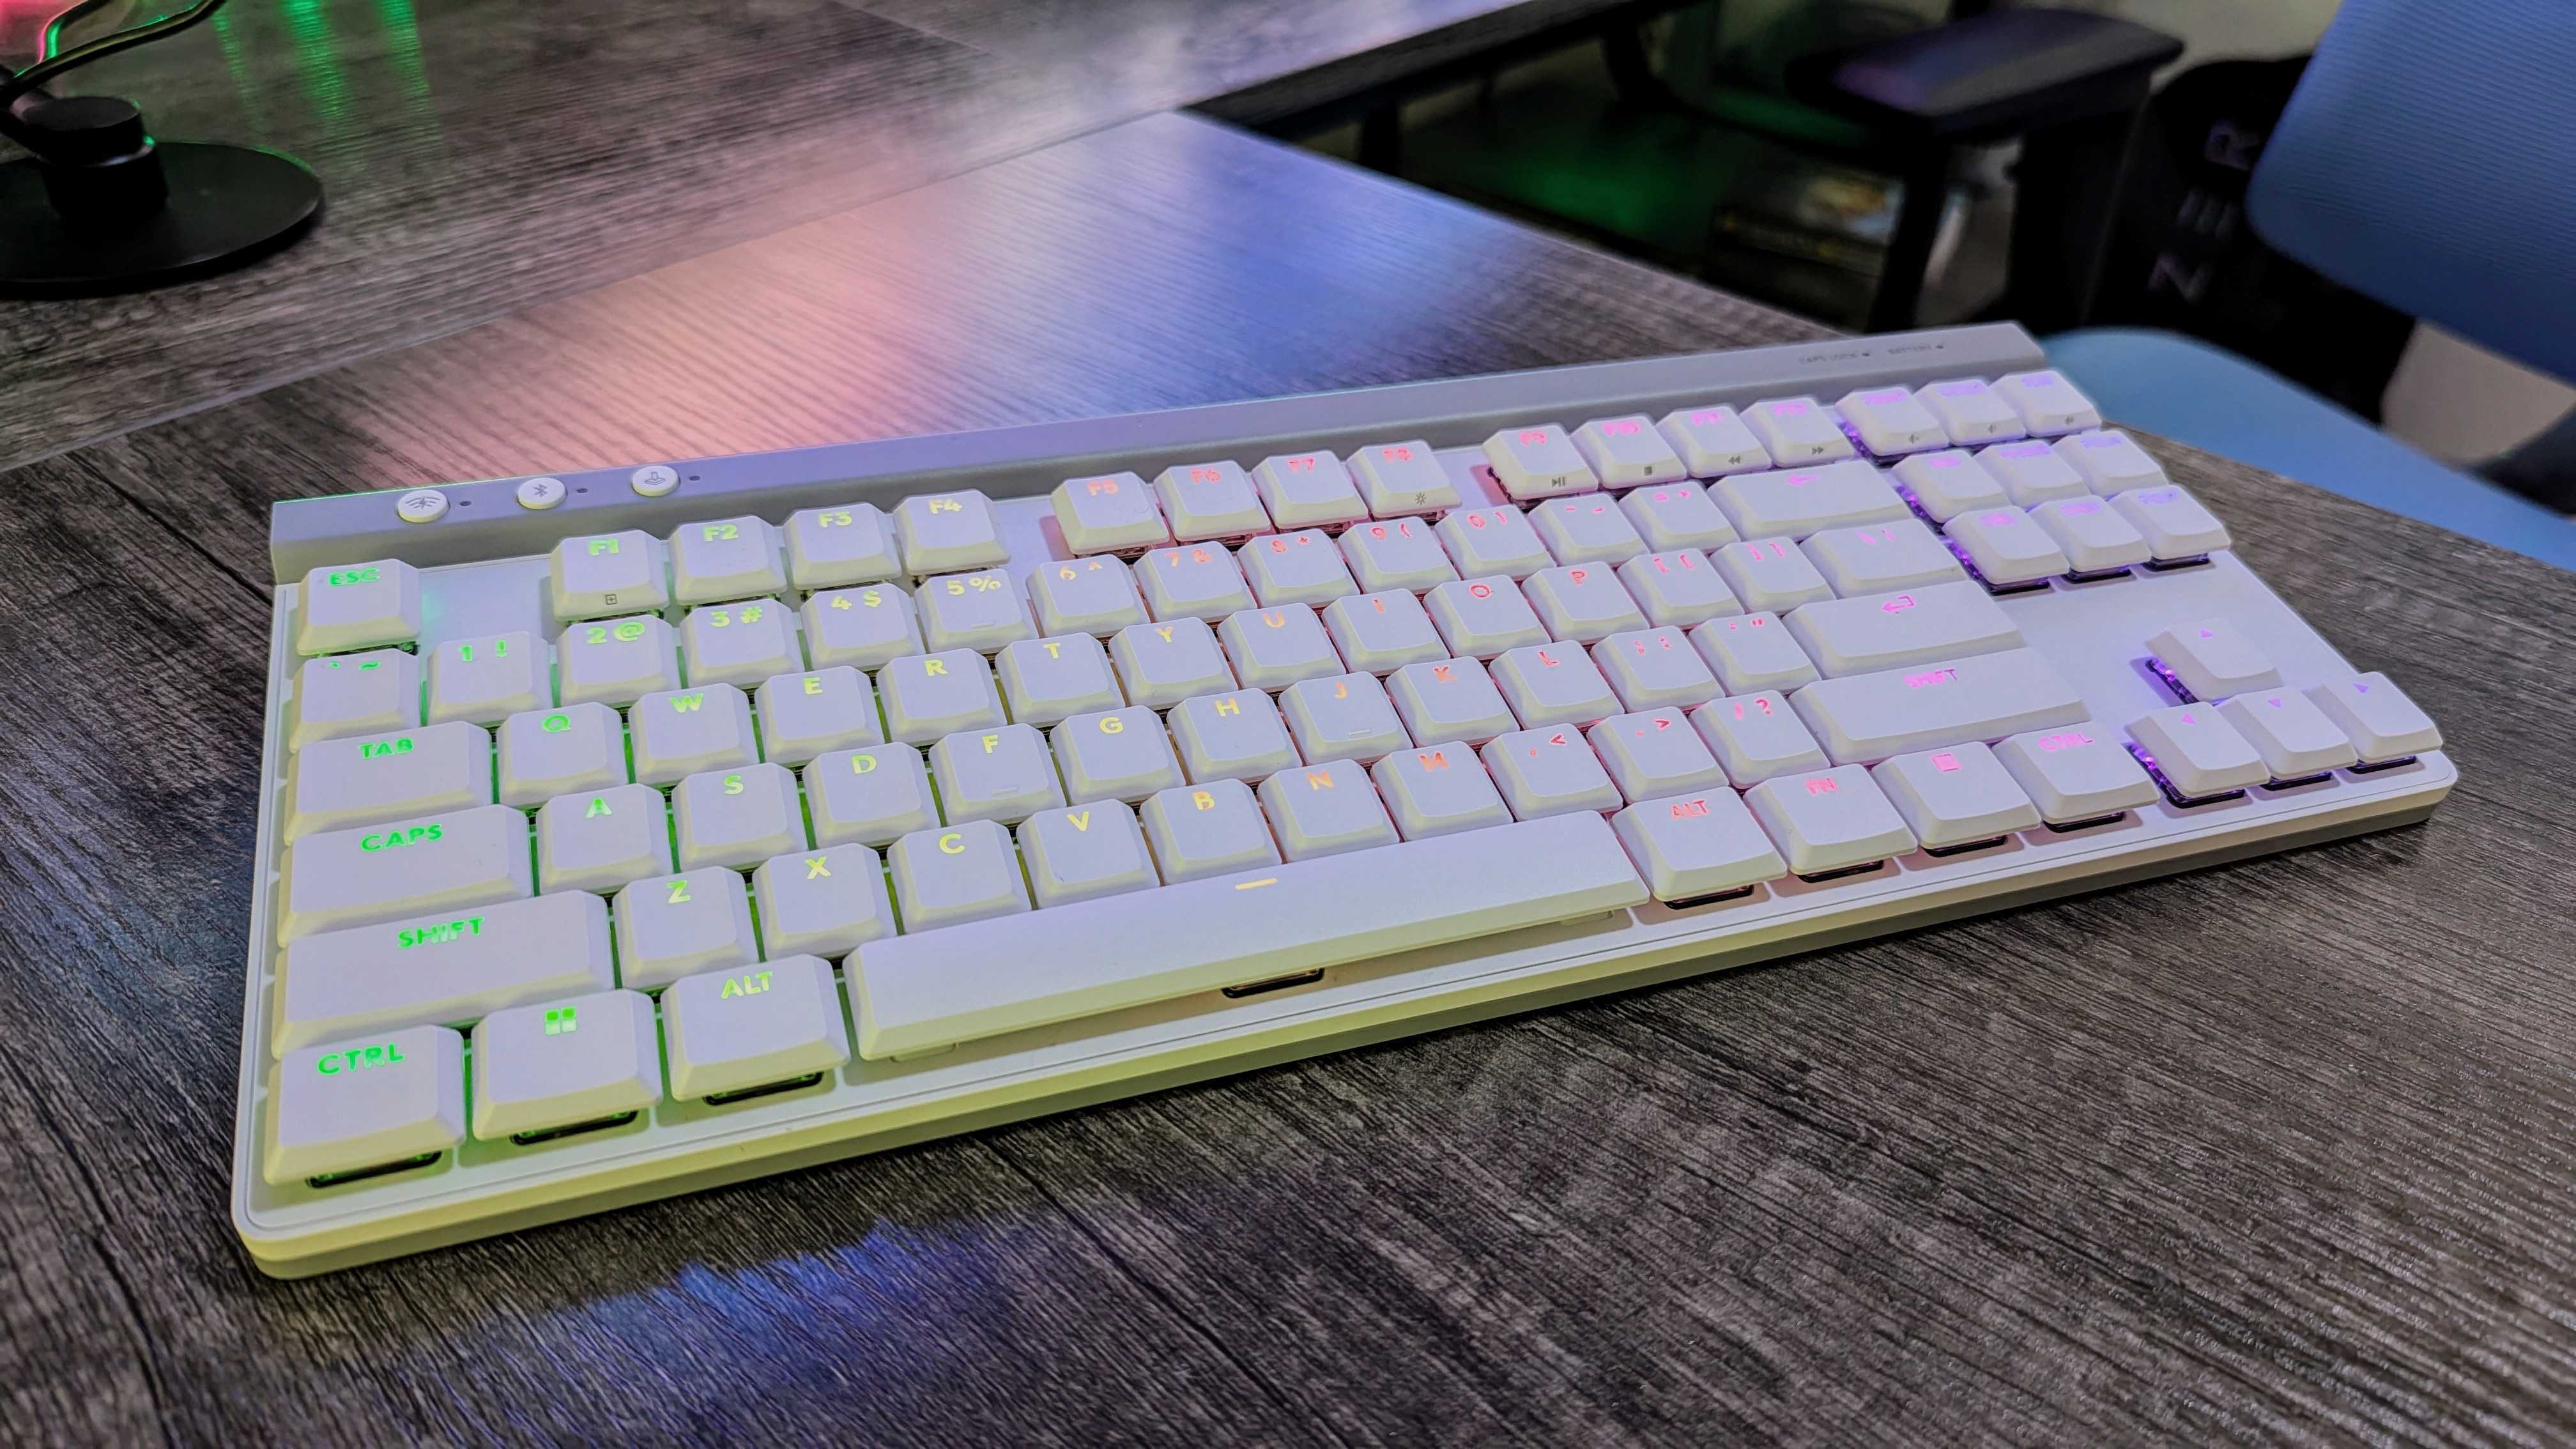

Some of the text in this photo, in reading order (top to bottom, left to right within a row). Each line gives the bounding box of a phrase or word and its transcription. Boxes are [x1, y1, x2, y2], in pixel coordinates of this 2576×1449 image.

[1288, 456, 1315, 473] F7
[1190, 466, 1221, 484] F6
[1087, 480, 1118, 496] F5
[930, 499, 962, 515] F4
[818, 511, 853, 527] F3
[702, 523, 739, 542] F2
[589, 539, 619, 556] F1
[1165, 552, 1180, 567] 7
[328, 567, 378, 586] ESC
[1059, 562, 1103, 580] 6 ^
[1570, 569, 1588, 585] P
[946, 576, 1002, 597] 5 %
[1469, 583, 1492, 599] O
[831, 590, 882, 610] 4 $
[711, 606, 762, 627] 3 #
[1263, 613, 1285, 628] U
[587, 620, 645, 644] 2 @
[1158, 628, 1172, 644] Y
[460, 640, 507, 662] 1 !
[1043, 642, 1059, 659] T
[1538, 650, 1559, 668] L
[924, 659, 947, 676] R
[1434, 664, 1456, 683] K
[803, 677, 822, 694] E
[1335, 682, 1348, 700] J
[670, 692, 703, 712] W
[1215, 698, 1241, 716] H
[1755, 698, 1773, 716] ?
[542, 713, 571, 733] Q
[1100, 716, 1124, 734] G
[1654, 718, 1671, 730] >
[358, 737, 414, 760] TAB
[983, 735, 997, 754] F
[1549, 733, 1565, 745] <
[851, 755, 877, 774] D
[1418, 751, 1448, 771] M
[724, 774, 742, 793] S
[1308, 771, 1333, 790] N
[587, 797, 611, 817] A
[1193, 791, 1215, 811] B
[1671, 799, 1709, 820] ALT
[1067, 811, 1089, 831] V
[360, 823, 443, 852] CAPS
[939, 832, 965, 855] C
[805, 855, 831, 879] X
[668, 880, 690, 902] Z
[398, 916, 484, 949] SHIFT
[721, 971, 772, 999] ALT
[317, 1043, 405, 1076] CTRL
